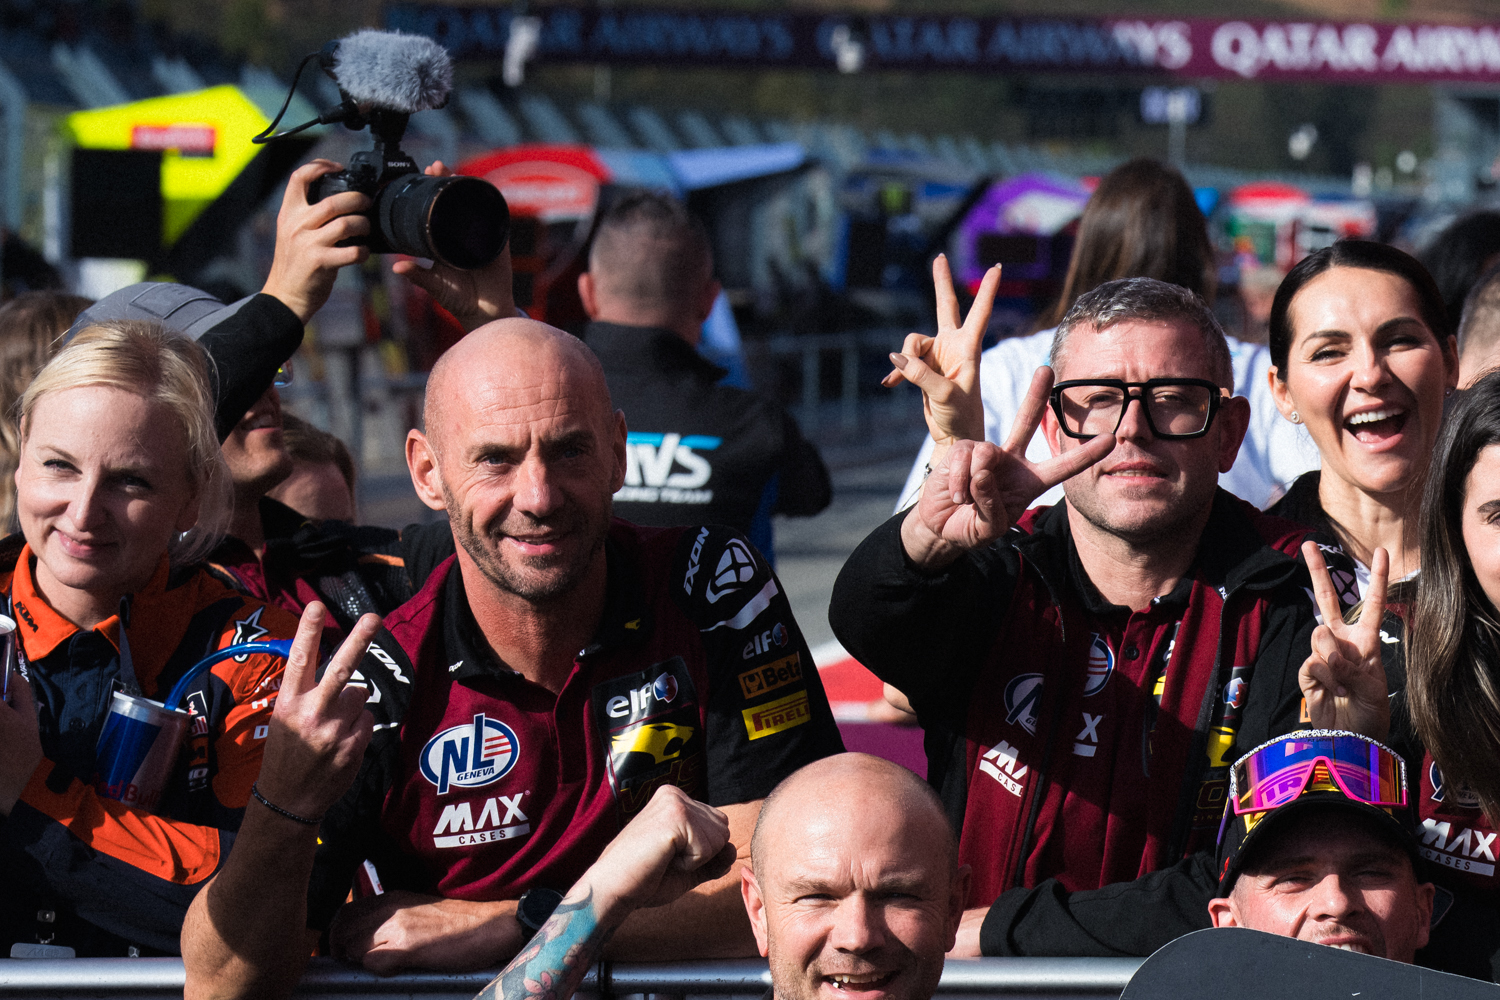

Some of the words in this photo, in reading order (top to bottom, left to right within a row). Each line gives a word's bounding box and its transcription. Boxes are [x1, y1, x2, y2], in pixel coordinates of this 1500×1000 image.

[1211, 21, 1378, 77] QATAR
[683, 526, 710, 596] IXON
[14, 601, 39, 633] KTM
[742, 629, 771, 660] elf
[606, 682, 653, 718] elf
[438, 714, 495, 794] NL
[457, 766, 495, 782] GENEVA
[433, 792, 529, 835] MAX
[458, 829, 507, 845] CASES
[1416, 817, 1498, 862] MAX
[1424, 848, 1471, 870] CASES
